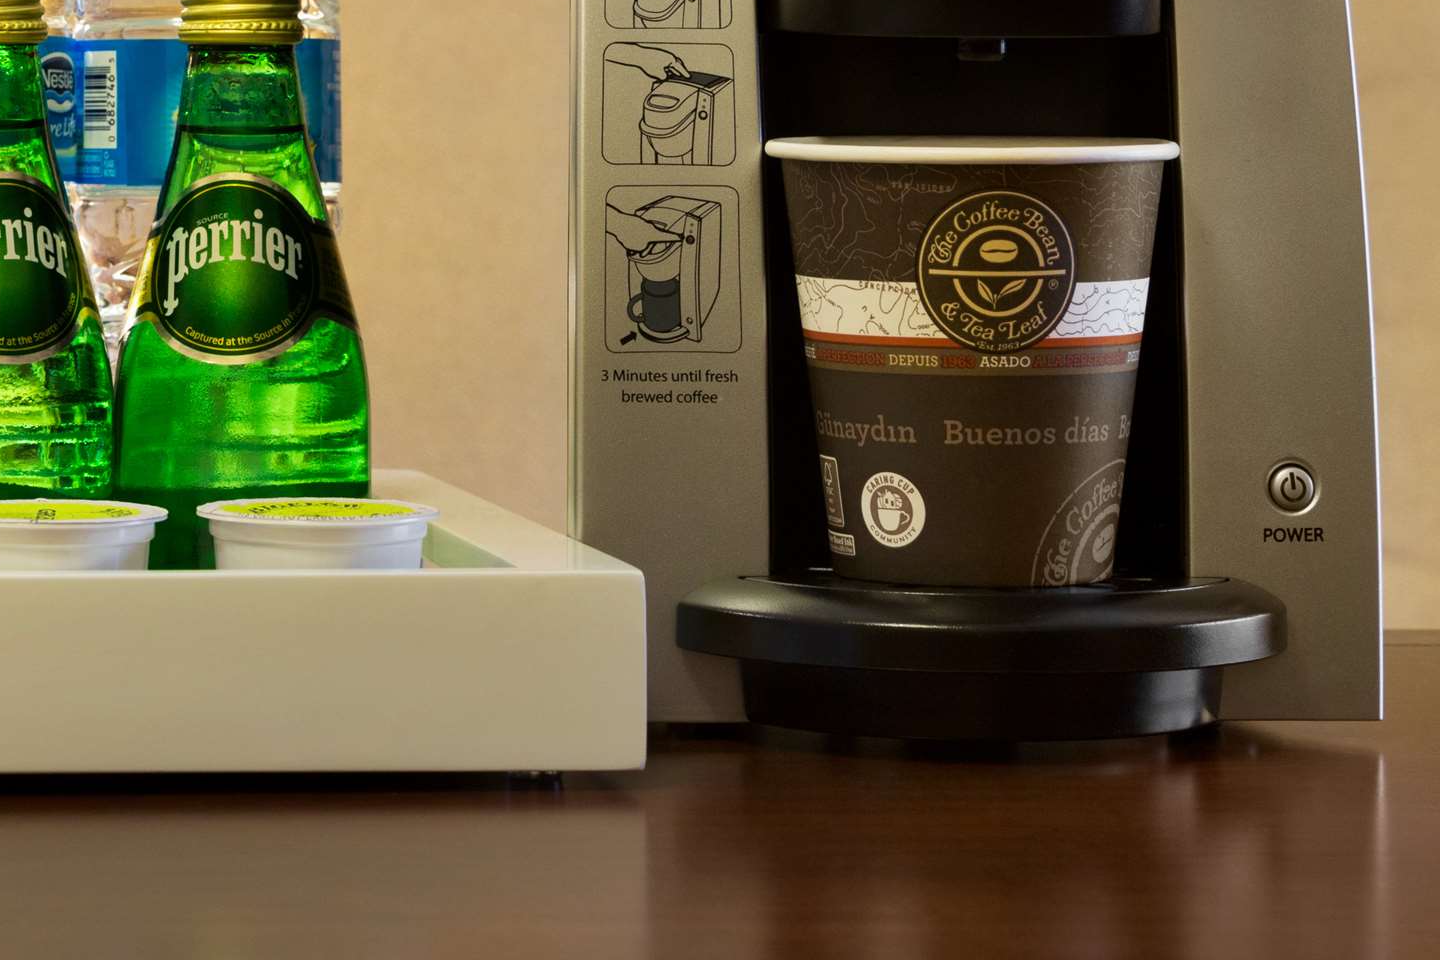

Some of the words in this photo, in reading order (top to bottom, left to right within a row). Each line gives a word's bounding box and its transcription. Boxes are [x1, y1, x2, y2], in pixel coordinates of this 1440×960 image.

[195, 212, 229, 226] SOURCE
[953, 200, 1021, 232] Coffee
[1023, 207, 1060, 266] Bean
[959, 312, 995, 341] Tea
[998, 300, 1048, 340] Leaf
[184, 325, 225, 347] Captured
[225, 337, 236, 347] at
[236, 334, 253, 346] the
[253, 325, 283, 343] Source
[888, 353, 939, 368] DEPUIS
[942, 355, 976, 369] 1963
[979, 355, 1032, 368] ASADO
[601, 369, 609, 382] 3
[612, 369, 668, 383] Minutes
[671, 369, 702, 383] until
[705, 369, 739, 383] fresh
[621, 389, 673, 403] brewed
[676, 389, 718, 403] coffee
[943, 419, 1057, 445] Buenos
[1064, 416, 1110, 444] días
[866, 474, 895, 495] CARING
[897, 478, 916, 496] CUP
[1065, 477, 1119, 535] Coffee
[869, 524, 918, 544] COMMUNITY
[1263, 527, 1325, 543] POWER
